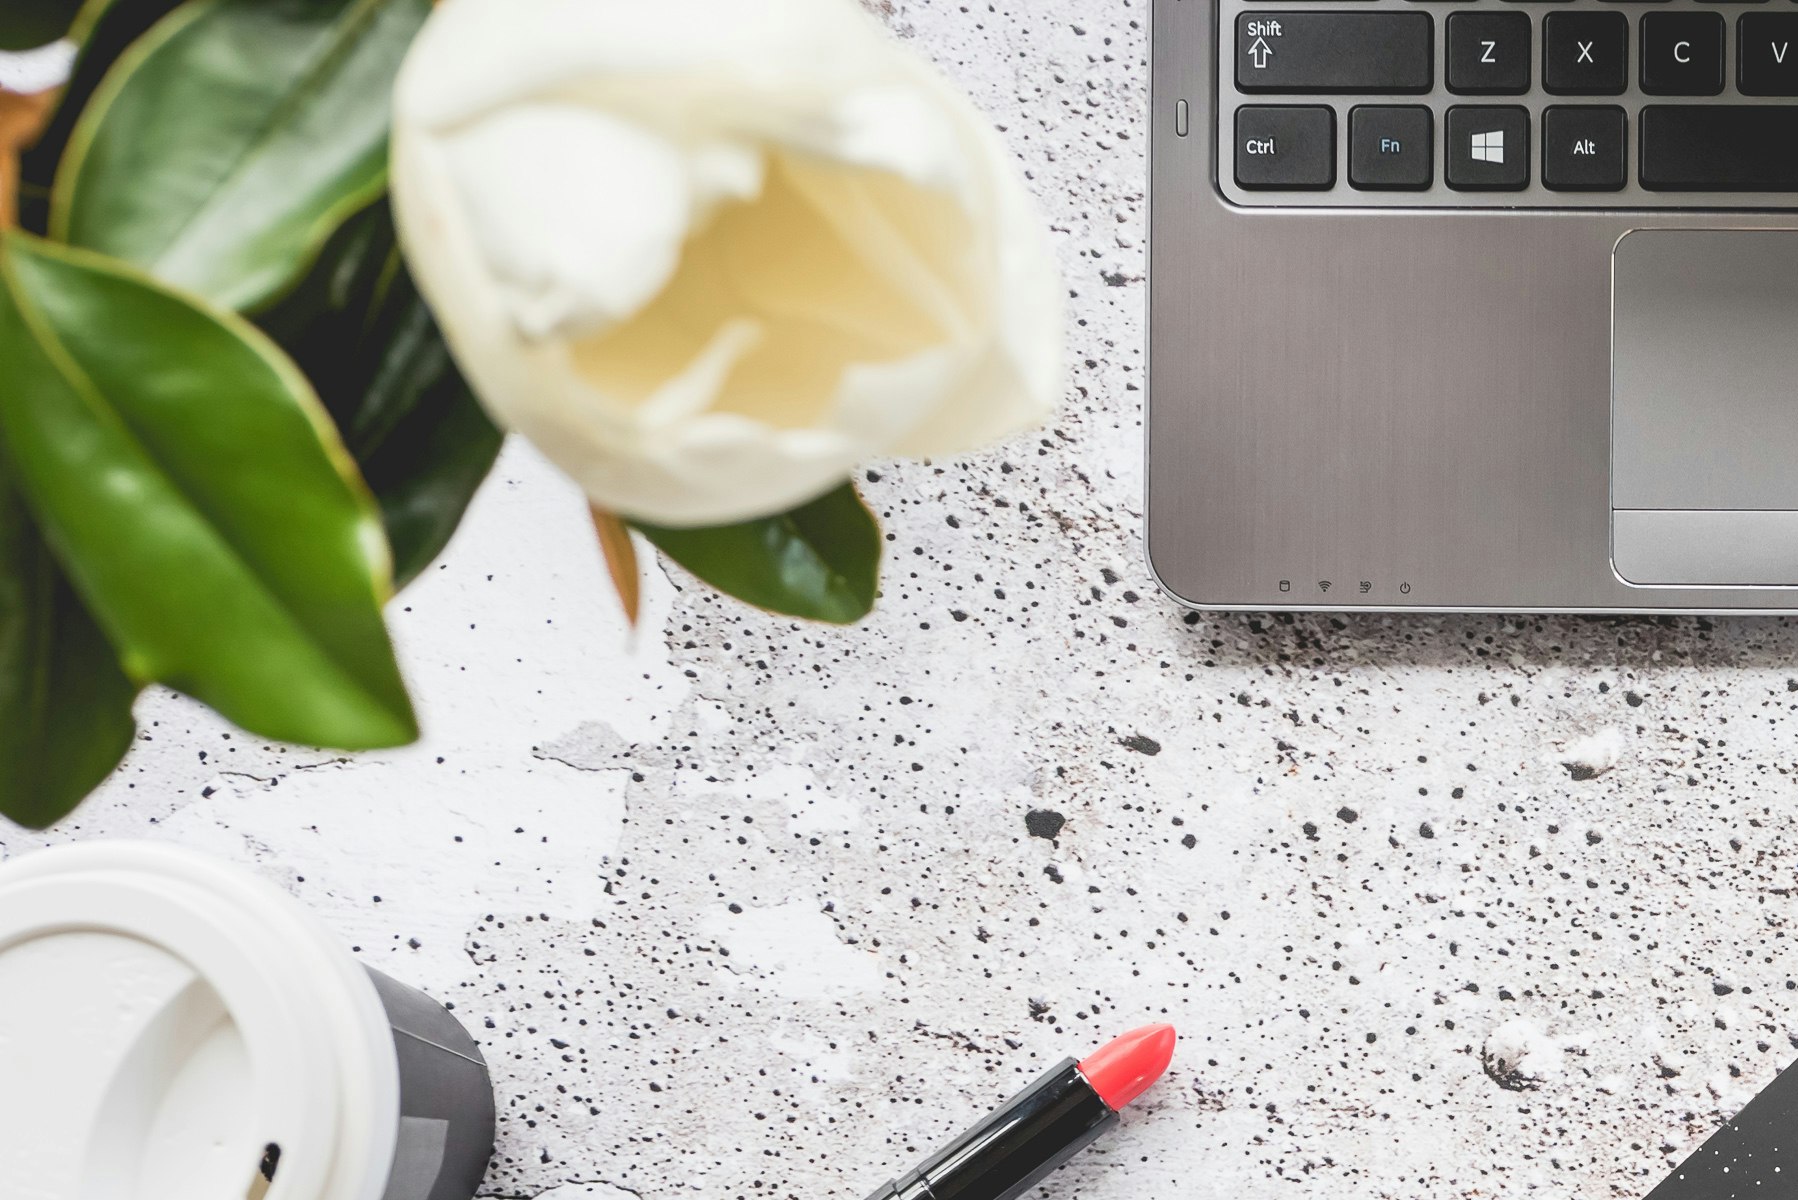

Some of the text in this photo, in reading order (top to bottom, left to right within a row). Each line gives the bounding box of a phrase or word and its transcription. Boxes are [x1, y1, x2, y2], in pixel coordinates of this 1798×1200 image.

[1247, 21, 1281, 37] Shift
[1480, 41, 1496, 63] Z
[1577, 41, 1594, 63] X
[1674, 41, 1690, 63] C
[1771, 41, 1788, 63] V
[1246, 138, 1275, 155] Ctrl
[1381, 138, 1400, 153] Fn
[1573, 139, 1596, 155] Alt
